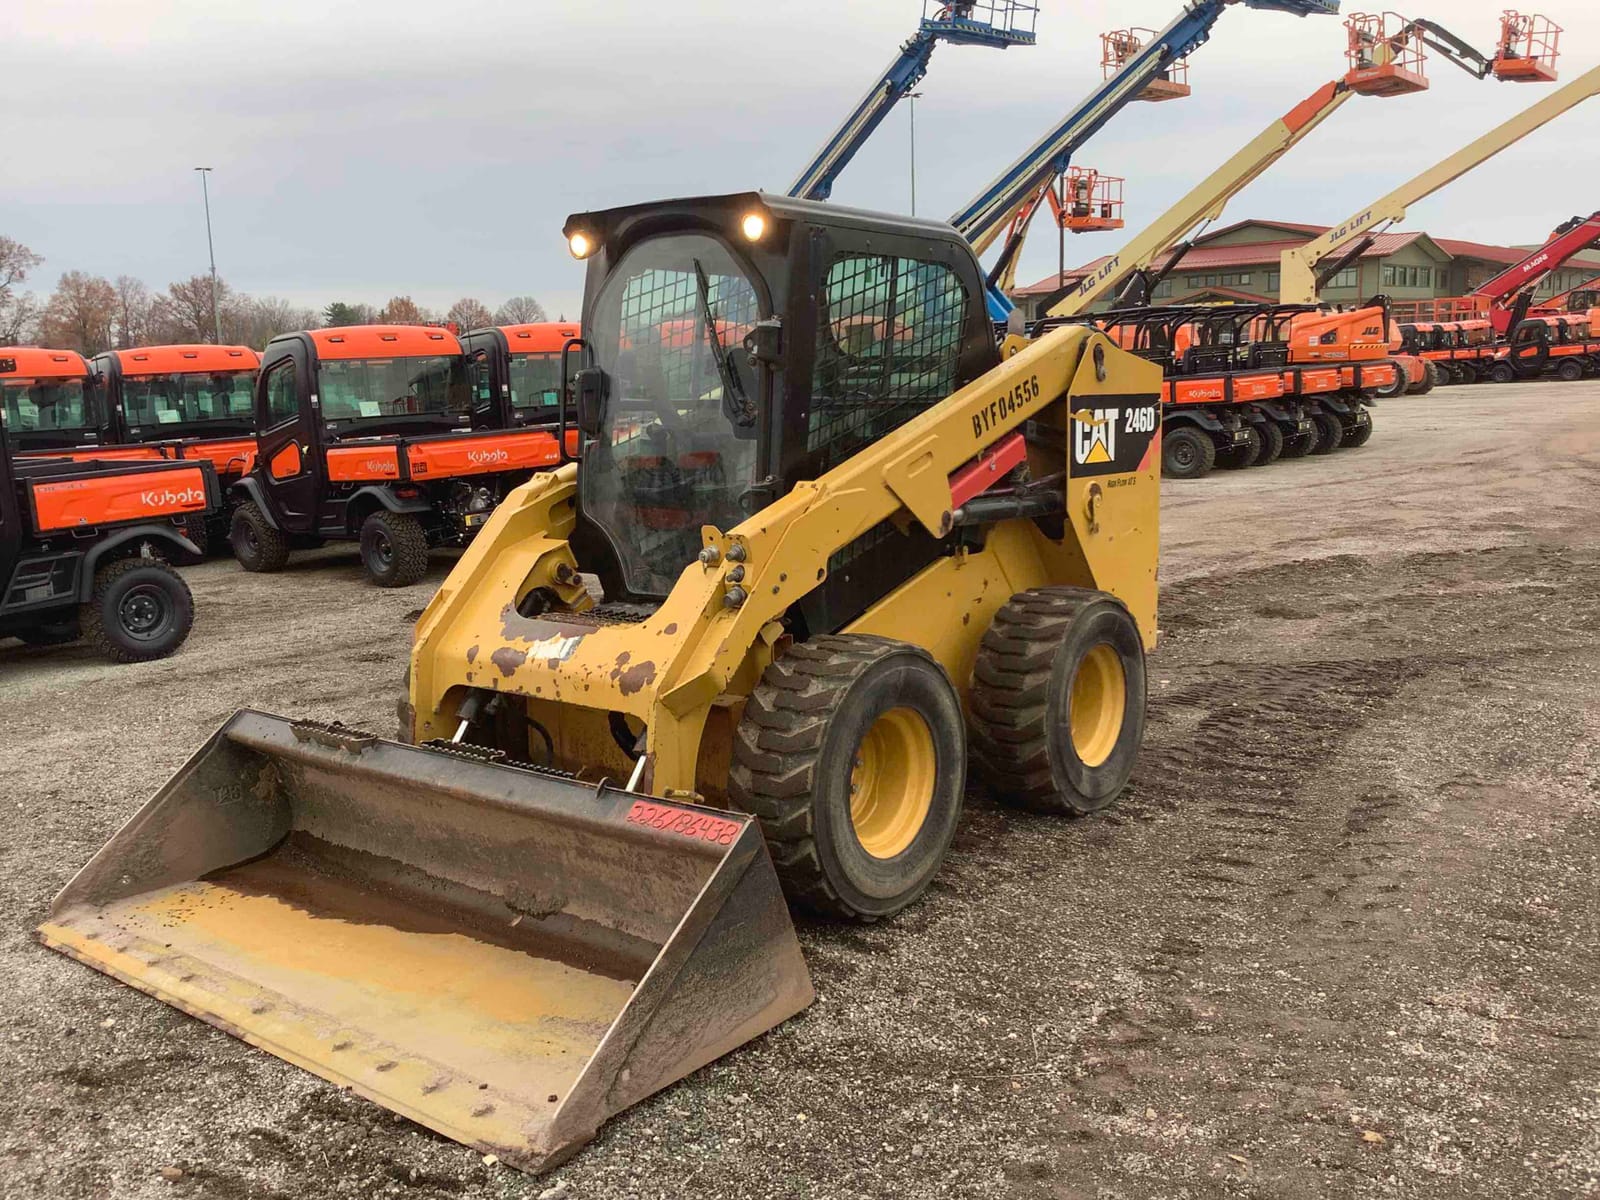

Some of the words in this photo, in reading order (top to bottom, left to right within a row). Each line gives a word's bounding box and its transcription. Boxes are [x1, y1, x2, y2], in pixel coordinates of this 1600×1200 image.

[1329, 226, 1347, 243] JLG
[1350, 211, 1371, 231] LIFT
[1078, 276, 1096, 297] JLG
[1098, 255, 1119, 280] LIFT
[1361, 326, 1380, 336] JLG
[1188, 389, 1221, 398] Kubota
[971, 374, 1041, 439] BYF04556
[1074, 407, 1120, 465] CAT
[1124, 406, 1156, 434] 246D
[466, 448, 509, 463] Kubota
[366, 460, 396, 473] Kubota
[140, 487, 205, 507] Kubota
